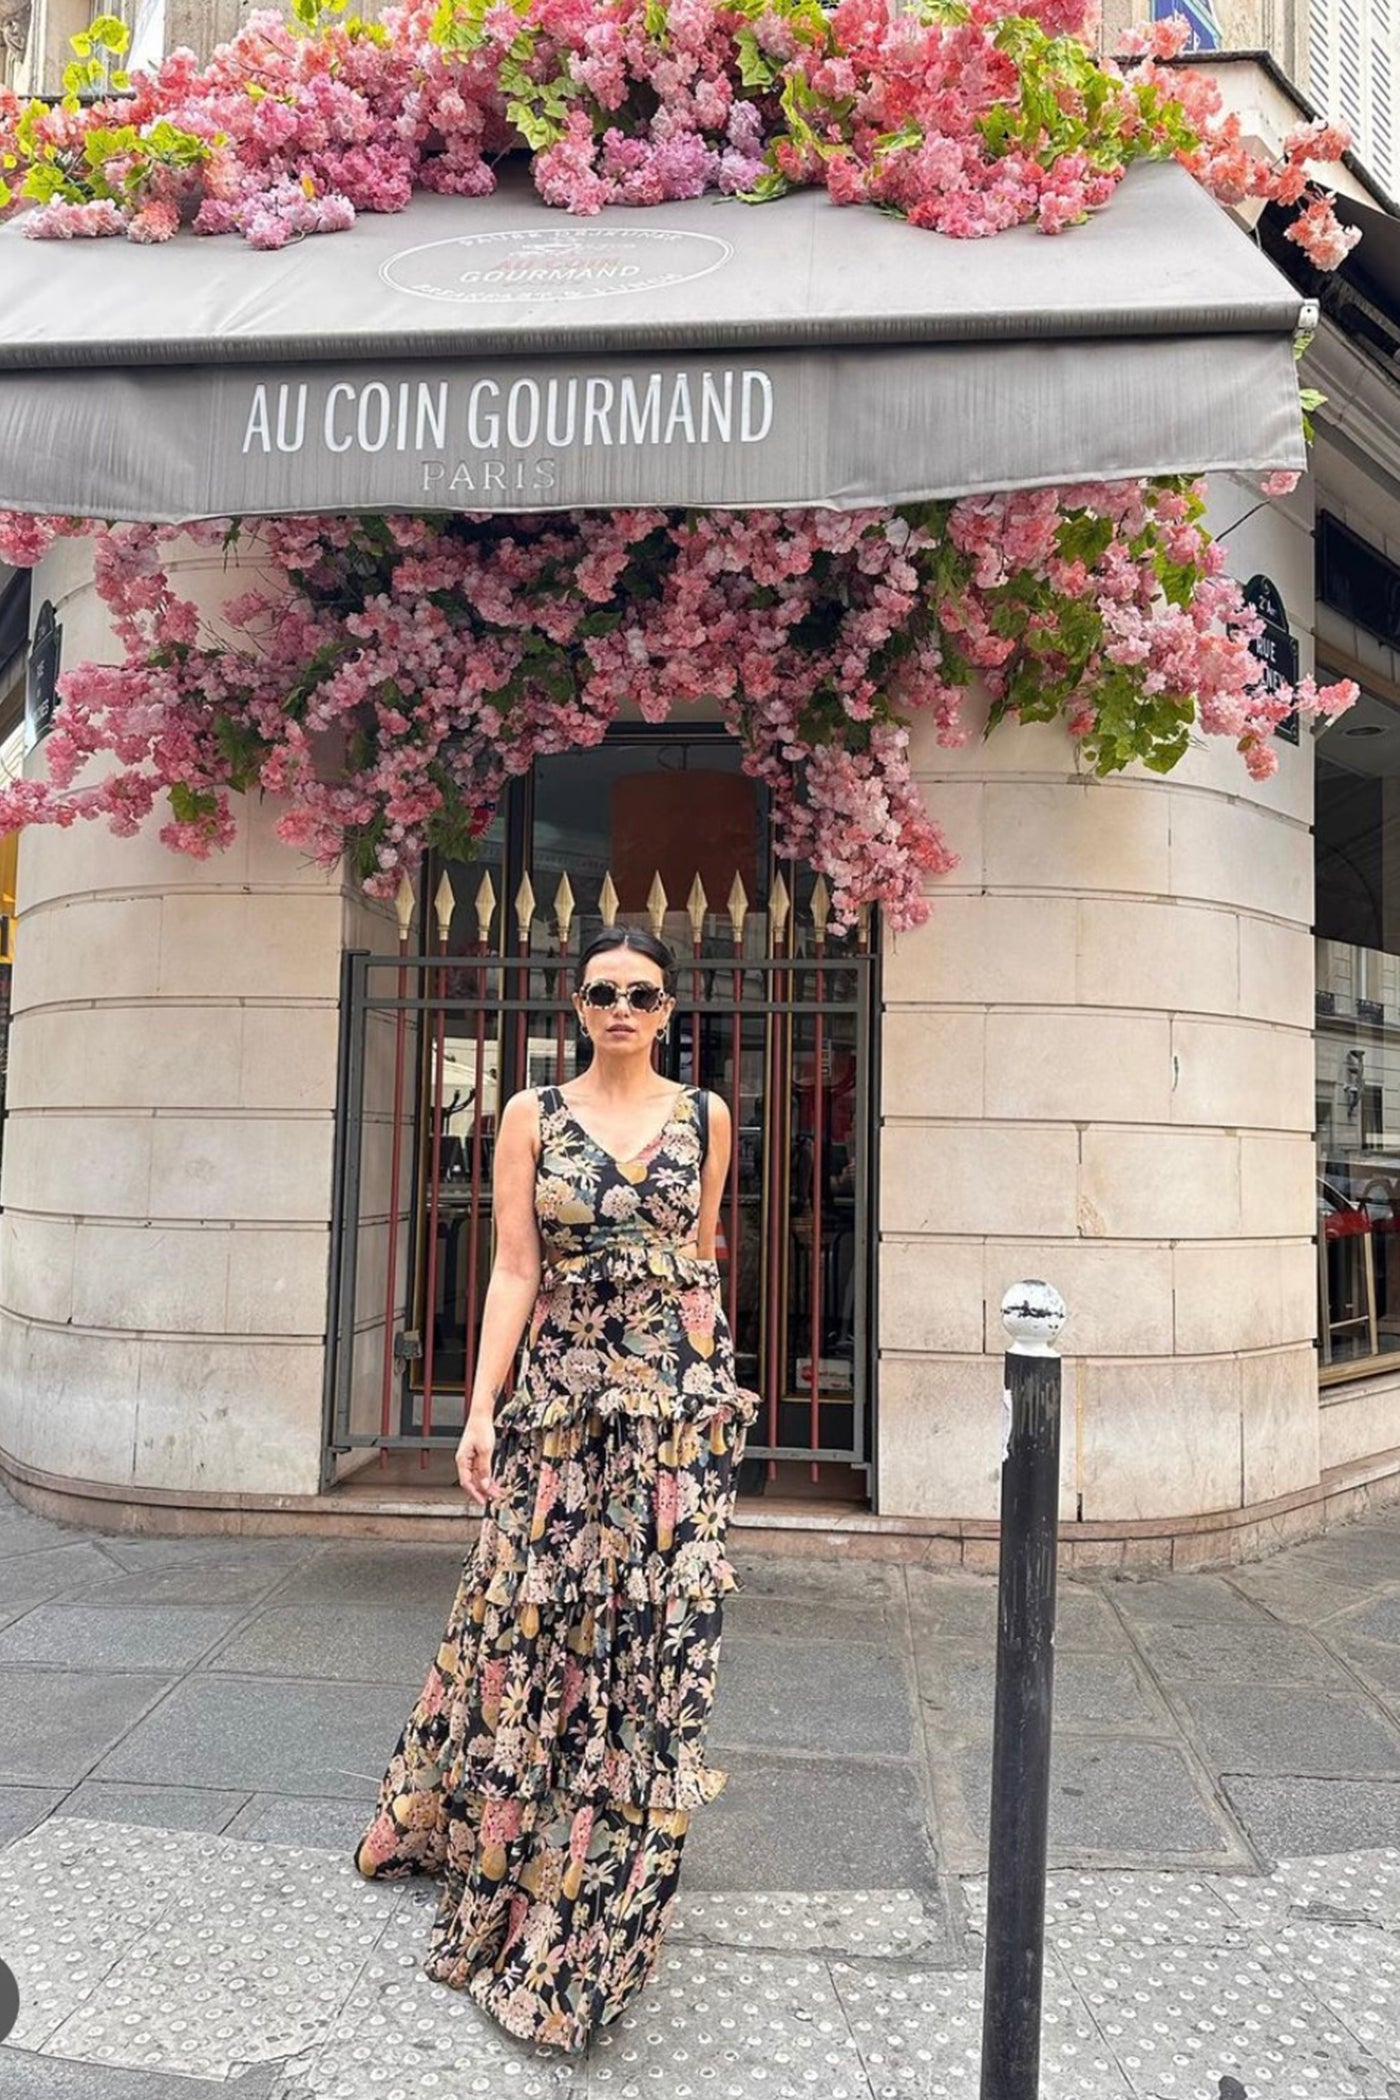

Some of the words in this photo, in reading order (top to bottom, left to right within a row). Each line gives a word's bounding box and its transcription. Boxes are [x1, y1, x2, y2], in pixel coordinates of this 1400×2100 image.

[459, 265, 641, 283] GOURMAND
[242, 384, 307, 453] AU
[325, 382, 448, 452] COIN
[468, 370, 774, 449] GOURMAND
[422, 458, 556, 491] PARIS
